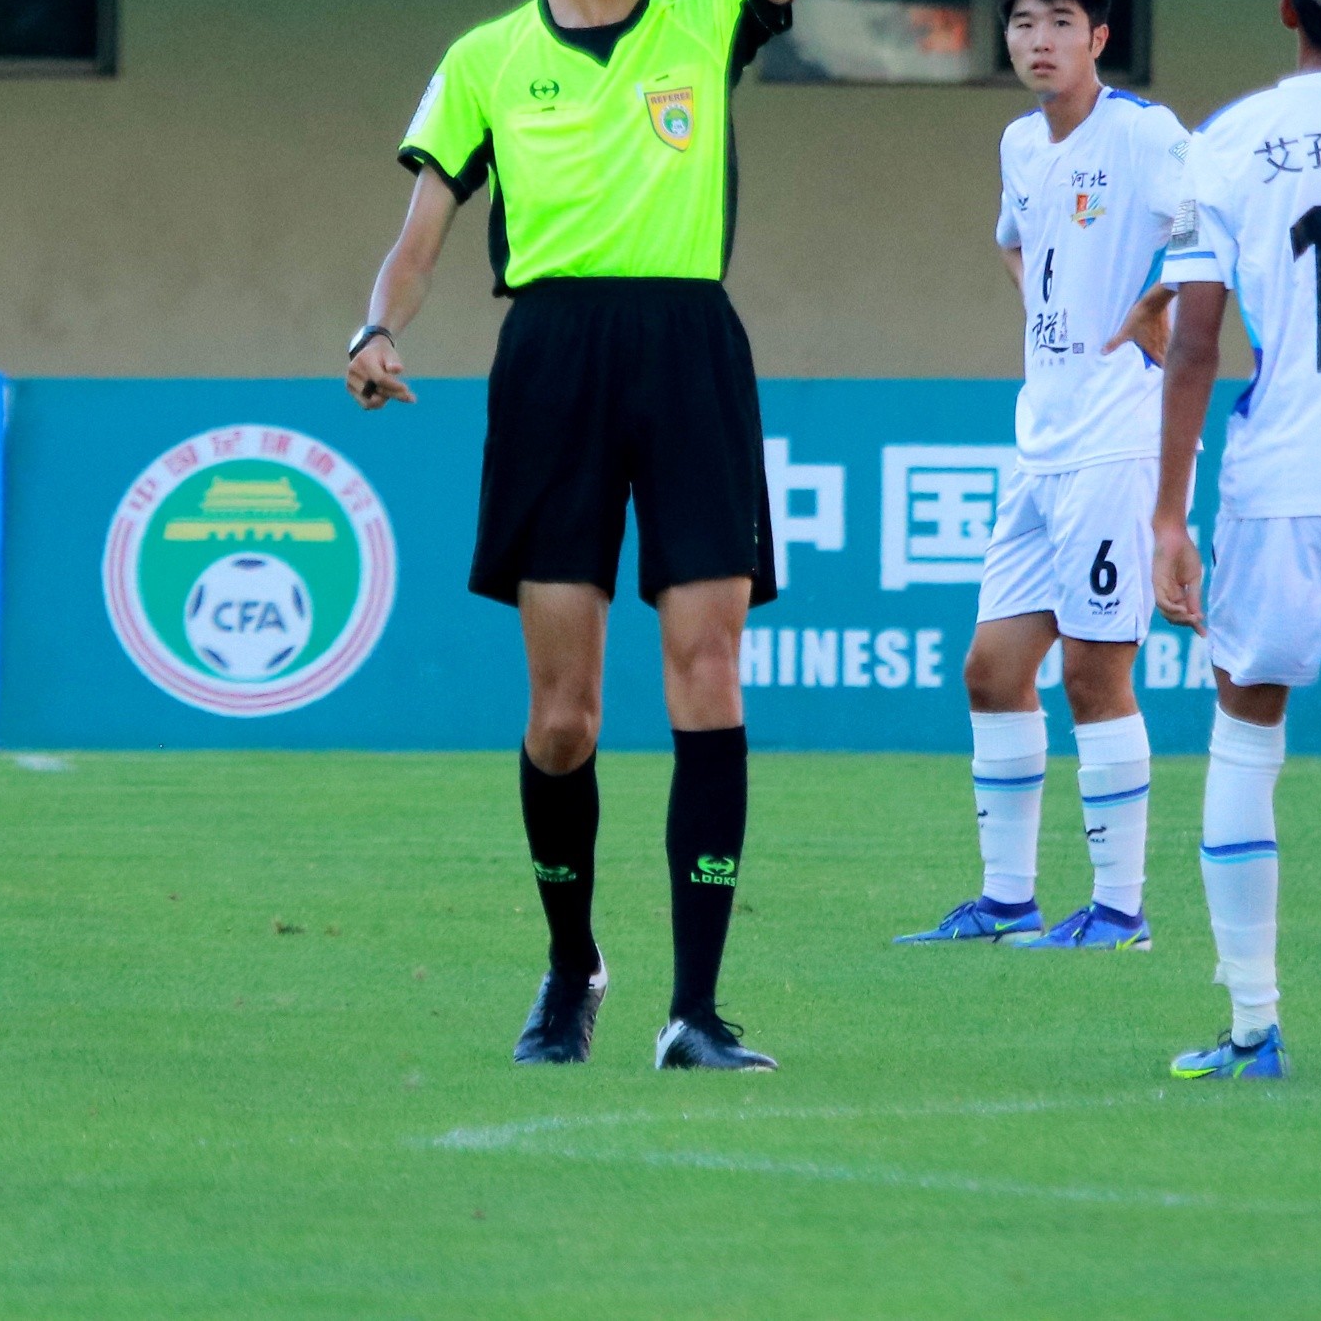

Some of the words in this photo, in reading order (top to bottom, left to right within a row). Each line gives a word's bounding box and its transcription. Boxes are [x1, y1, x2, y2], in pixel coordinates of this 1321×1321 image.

[1071, 170, 1108, 188] 河北
[1089, 540, 1118, 595] 6
[212, 601, 286, 633] CFA
[739, 628, 944, 689] HINESE
